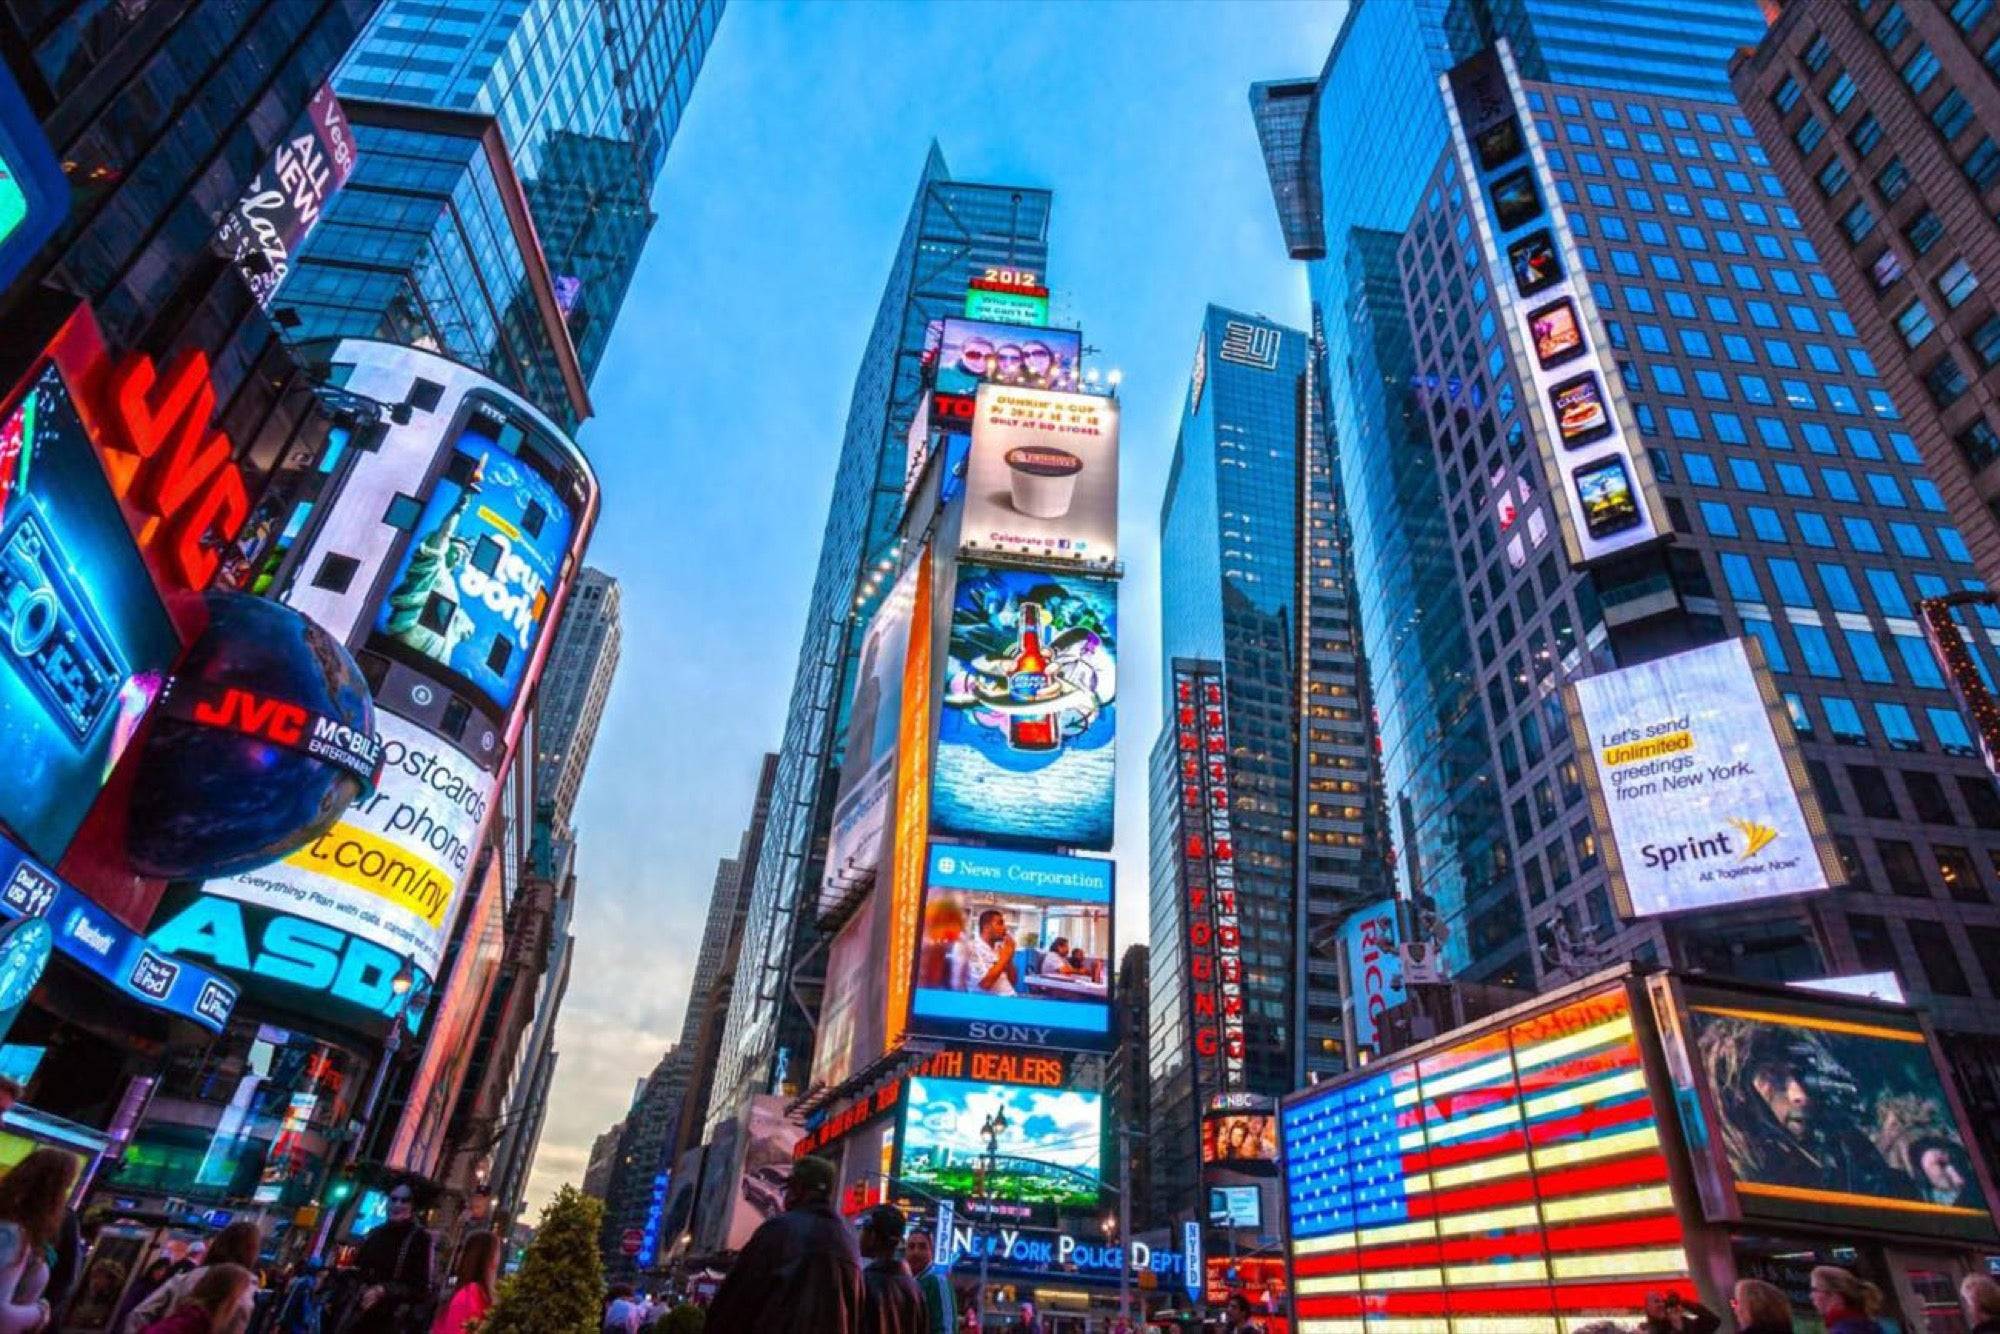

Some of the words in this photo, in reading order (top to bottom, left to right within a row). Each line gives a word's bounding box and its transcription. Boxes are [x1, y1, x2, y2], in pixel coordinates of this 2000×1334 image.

[275, 144, 320, 224] NEW
[291, 134, 330, 199] ALL
[985, 268, 1035, 287] 2012
[120, 350, 249, 592] JVC
[193, 689, 308, 746] JVC
[1602, 726, 1640, 748] Let's
[1646, 714, 1690, 737] send
[314, 715, 381, 768] MOBILE
[1607, 733, 1689, 766] Unlimited
[374, 731, 486, 824] ostcards
[1611, 755, 1694, 786] greetings
[1617, 781, 1656, 801] from
[1663, 771, 1704, 792] New
[1708, 761, 1754, 782] York.
[1641, 831, 1733, 871] Sprint
[238, 873, 307, 900] Everything
[959, 861, 1001, 878] News
[1008, 865, 1104, 889] Corporation
[1189, 886, 1218, 1057] YOUNG
[1360, 918, 1387, 1043] RICO
[968, 1022, 1051, 1044] SONY
[971, 1052, 1063, 1087] DEALERS
[1226, 1093, 1253, 1108] NBC
[1187, 1223, 1199, 1285] NYPD
